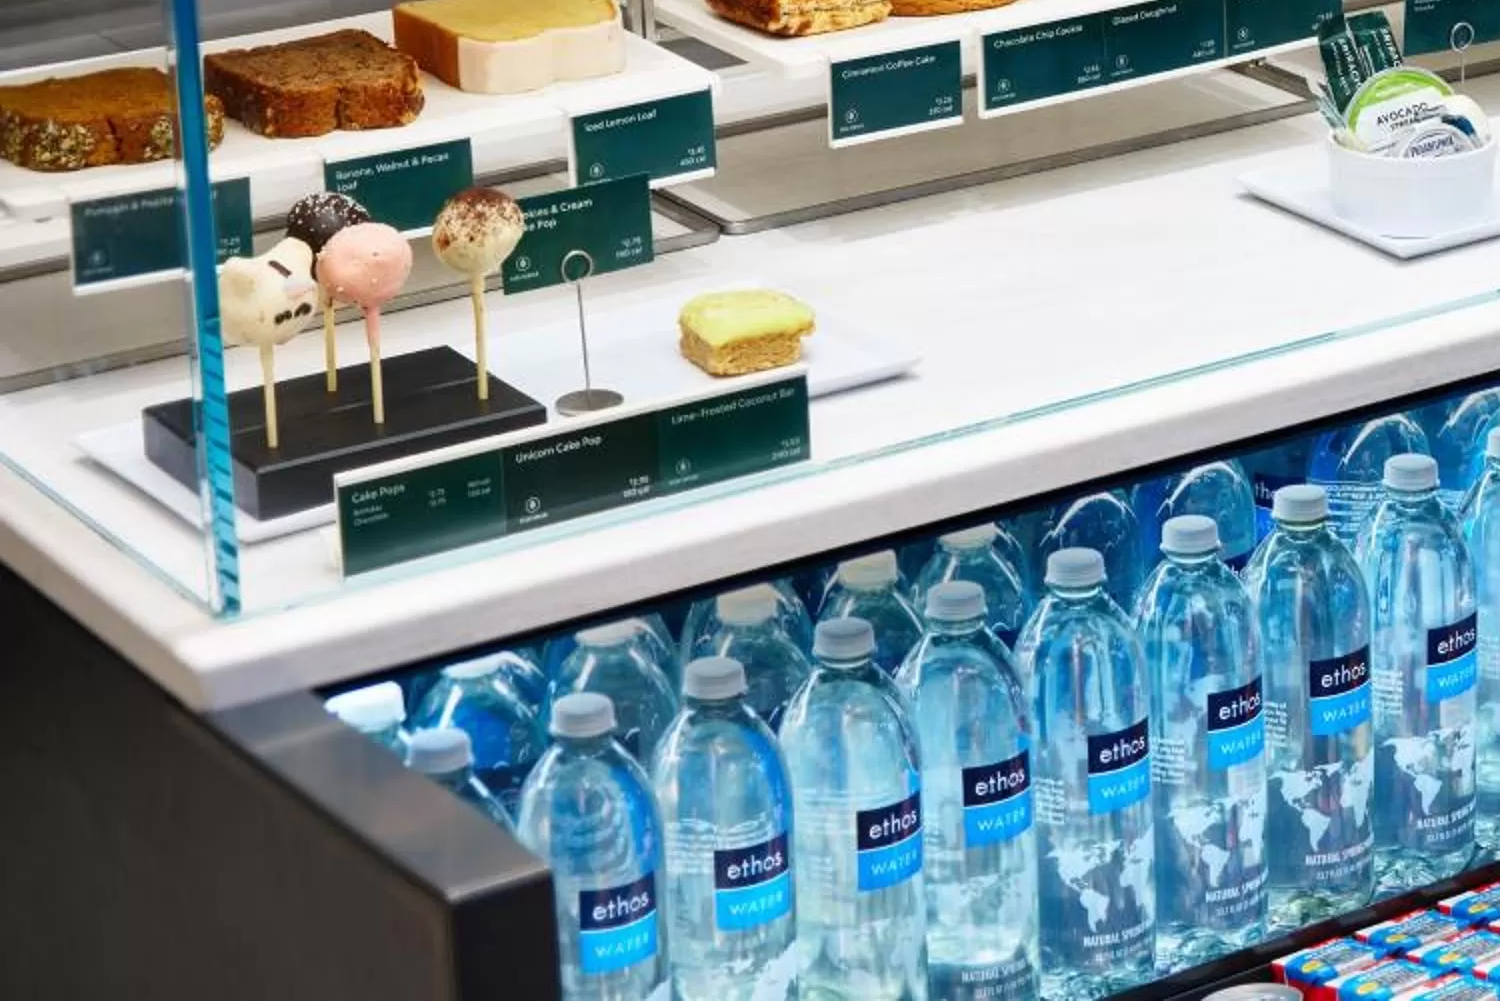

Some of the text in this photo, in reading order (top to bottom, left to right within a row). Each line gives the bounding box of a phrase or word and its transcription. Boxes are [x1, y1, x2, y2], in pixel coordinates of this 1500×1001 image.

[604, 112, 637, 130] Lemon
[636, 108, 657, 124] Loaf
[1375, 101, 1429, 127] AVOCADO
[375, 159, 411, 174] Walnut
[336, 180, 358, 193] Loaf
[559, 197, 594, 213] Cream
[536, 217, 558, 232] Pop
[514, 447, 556, 465] Unicorn
[581, 434, 603, 449] Pop
[350, 483, 406, 505] Cake Pops
[1437, 628, 1475, 655] ethos
[1320, 662, 1366, 688] ethos
[1218, 693, 1261, 721] ethos
[1099, 736, 1146, 765] ethos
[974, 767, 1026, 797] ethos
[868, 808, 918, 841] ethos
[726, 851, 783, 880] ethos
[592, 890, 650, 921] ethos
